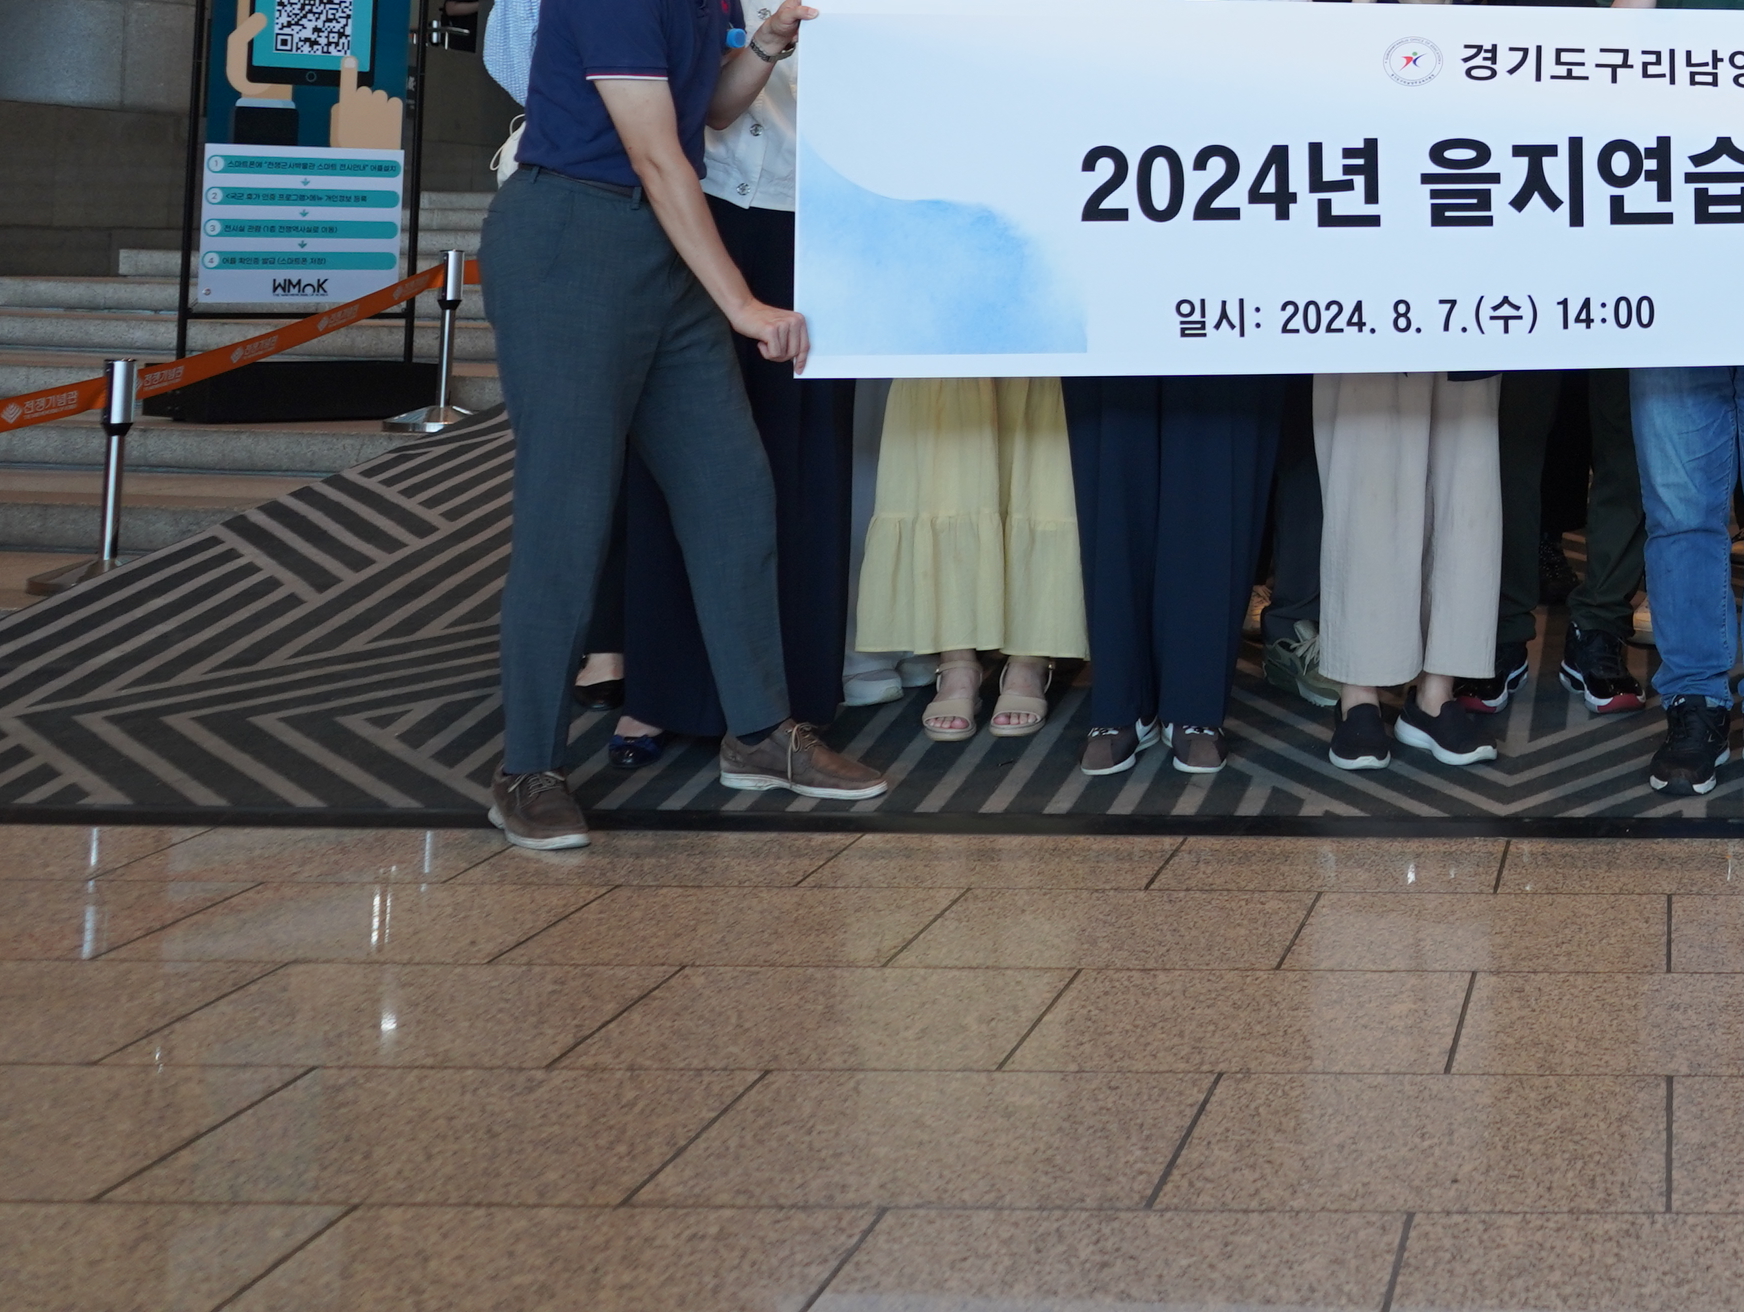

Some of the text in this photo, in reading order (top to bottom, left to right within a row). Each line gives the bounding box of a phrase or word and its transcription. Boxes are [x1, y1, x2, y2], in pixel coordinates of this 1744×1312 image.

[1081, 137, 1382, 228] 2024년
[1175, 294, 1655, 338] 일시: 2024. 8. 7.(수) 14:00
[23, 390, 79, 414] 전쟁기념관
